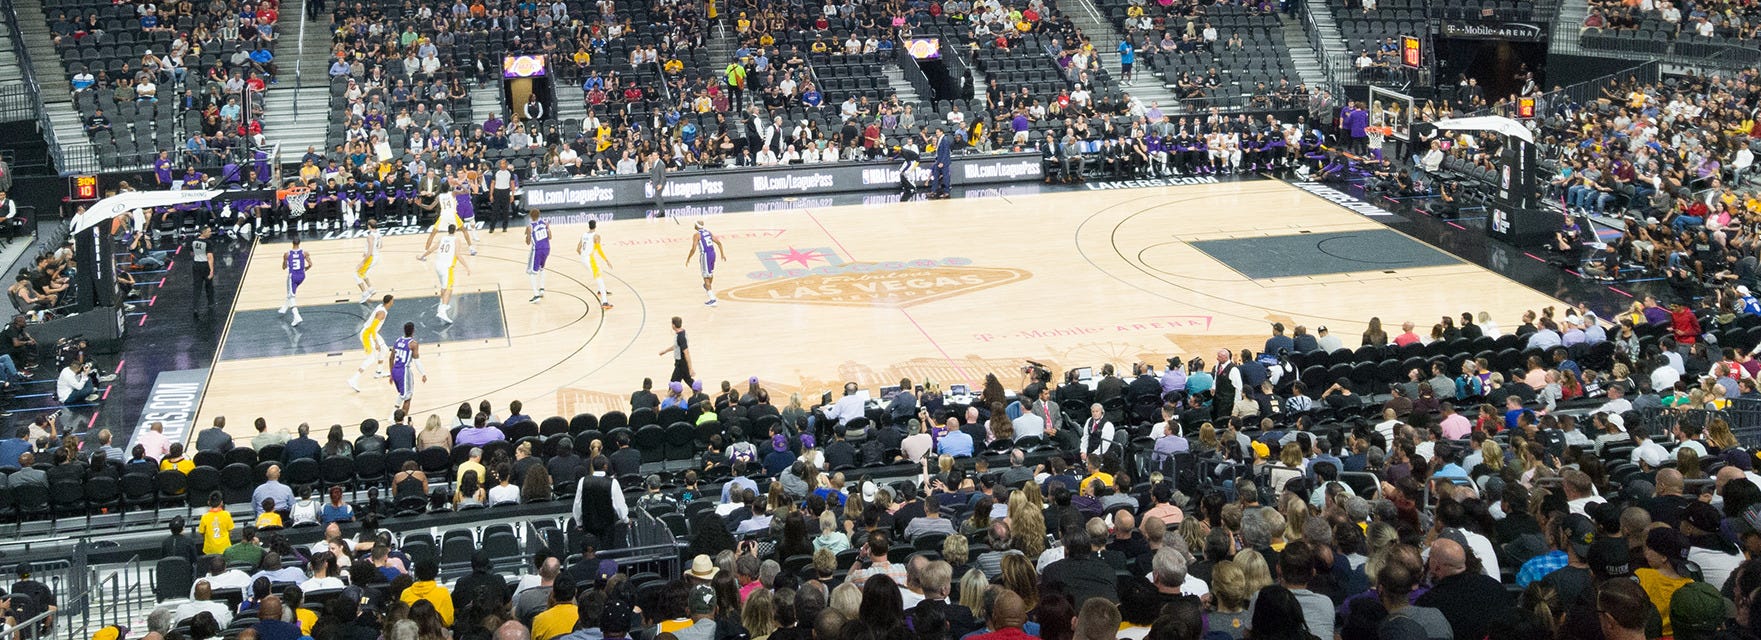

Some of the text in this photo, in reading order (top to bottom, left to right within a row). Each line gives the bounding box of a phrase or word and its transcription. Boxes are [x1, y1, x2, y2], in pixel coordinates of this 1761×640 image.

[1500, 29, 1533, 37] ARENA
[869, 168, 886, 184] NBA
[965, 160, 1041, 179] NBA.com/LeaguePass
[670, 181, 701, 198] League
[701, 179, 723, 195] Pass
[753, 173, 834, 191] NBA.com/LeaguePass
[1086, 176, 1219, 190] LAKERS.COM
[80, 186, 92, 196] 10
[527, 186, 614, 206] NBA.com/LeaguePass
[440, 243, 451, 254] 40
[292, 259, 301, 270] 3
[768, 274, 985, 299] LAS VEGAS
[1115, 319, 1202, 332] ARENA
